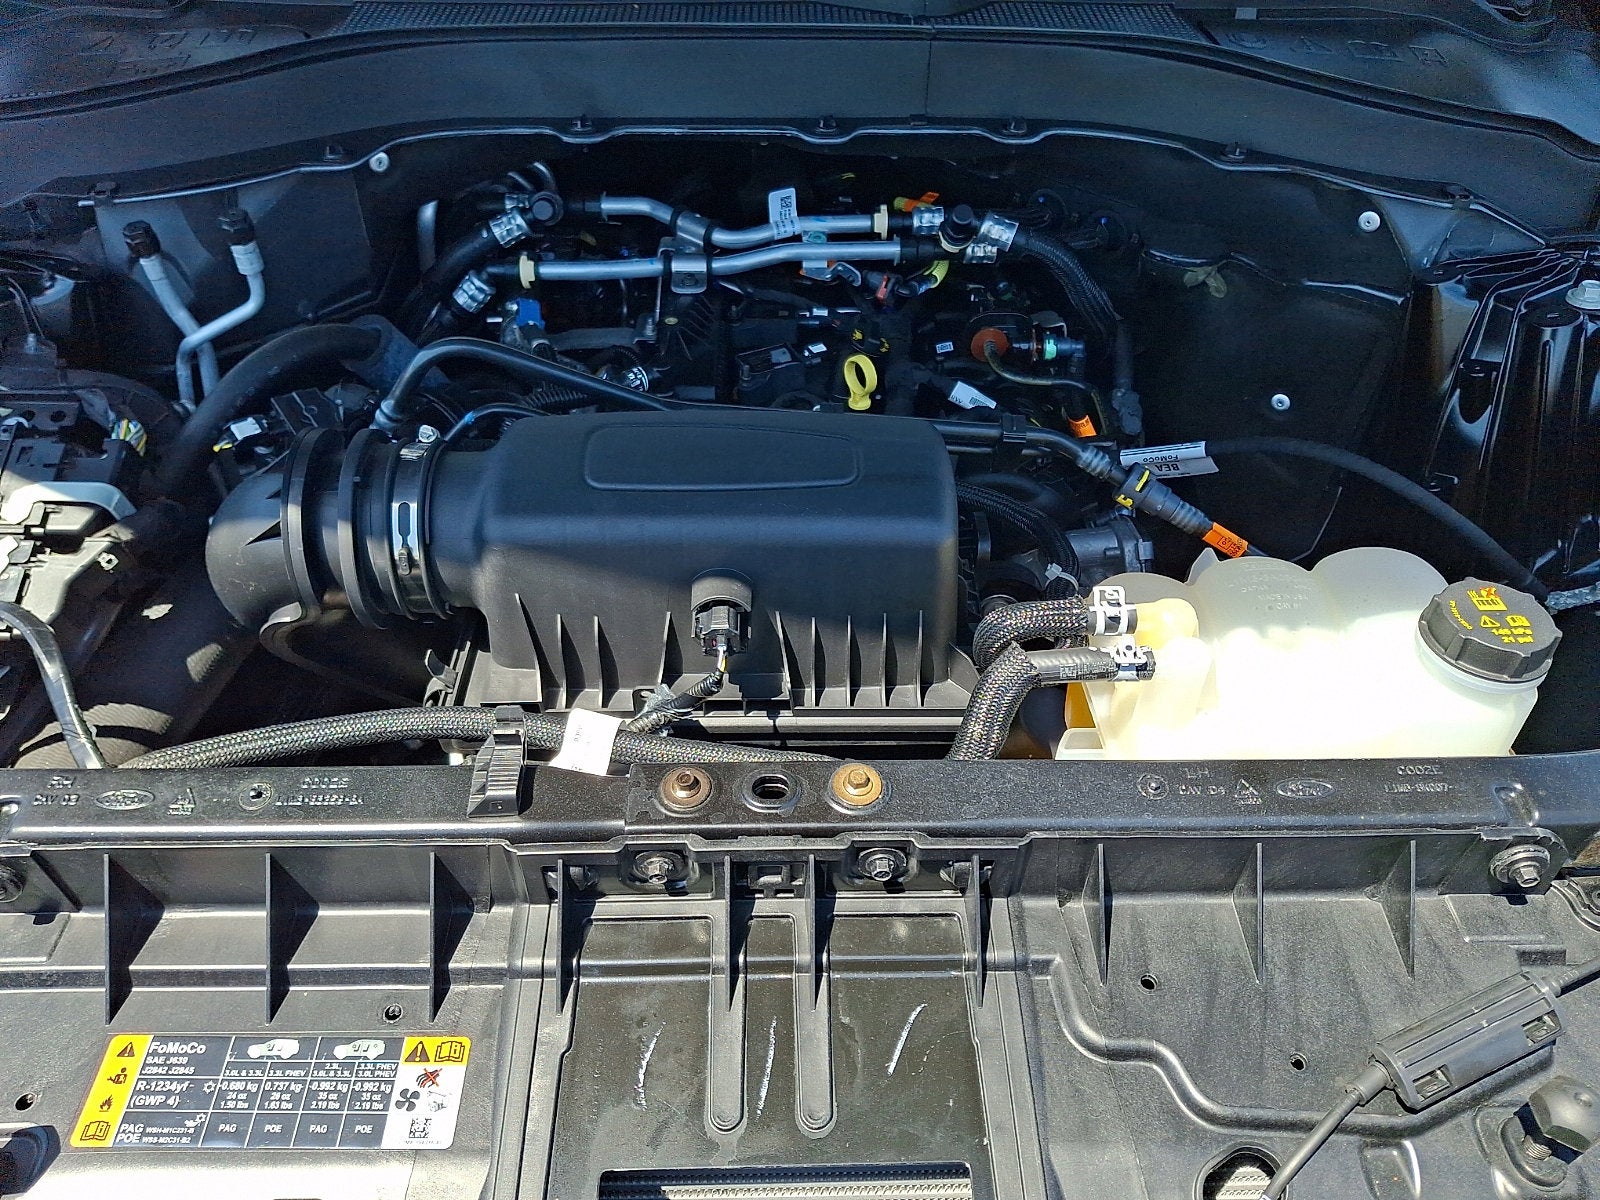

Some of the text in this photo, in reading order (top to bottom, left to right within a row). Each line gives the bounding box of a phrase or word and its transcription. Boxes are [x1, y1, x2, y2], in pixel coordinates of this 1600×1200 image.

[1142, 454, 1179, 463] FoMoCo
[1155, 463, 1180, 472] BEA
[148, 1041, 207, 1055] FoMoCo
[145, 1056, 189, 1065] SAE J639
[141, 1066, 196, 1075] J2842 J2845
[285, 1069, 306, 1077] FHEV
[135, 1080, 190, 1094] R-1234yf
[245, 1081, 259, 1093] kg
[265, 1081, 303, 1093] 0.737 kg
[337, 1081, 349, 1093] kg
[380, 1081, 392, 1093] kg
[130, 1095, 180, 1108] (GWP 4)
[226, 1093, 236, 1101] 24
[317, 1093, 327, 1101] 35
[361, 1093, 371, 1101] 35
[236, 1101, 249, 1109] lbs
[280, 1101, 293, 1109] lbs
[310, 1101, 340, 1110] 2.19 lbs
[354, 1101, 384, 1110] 2.19 lbs
[119, 1124, 145, 1133] PAG
[218, 1124, 237, 1133] PAG
[264, 1124, 282, 1133] POE
[309, 1124, 328, 1133] PAG
[354, 1124, 373, 1134] POE
[116, 1133, 141, 1143] POE
